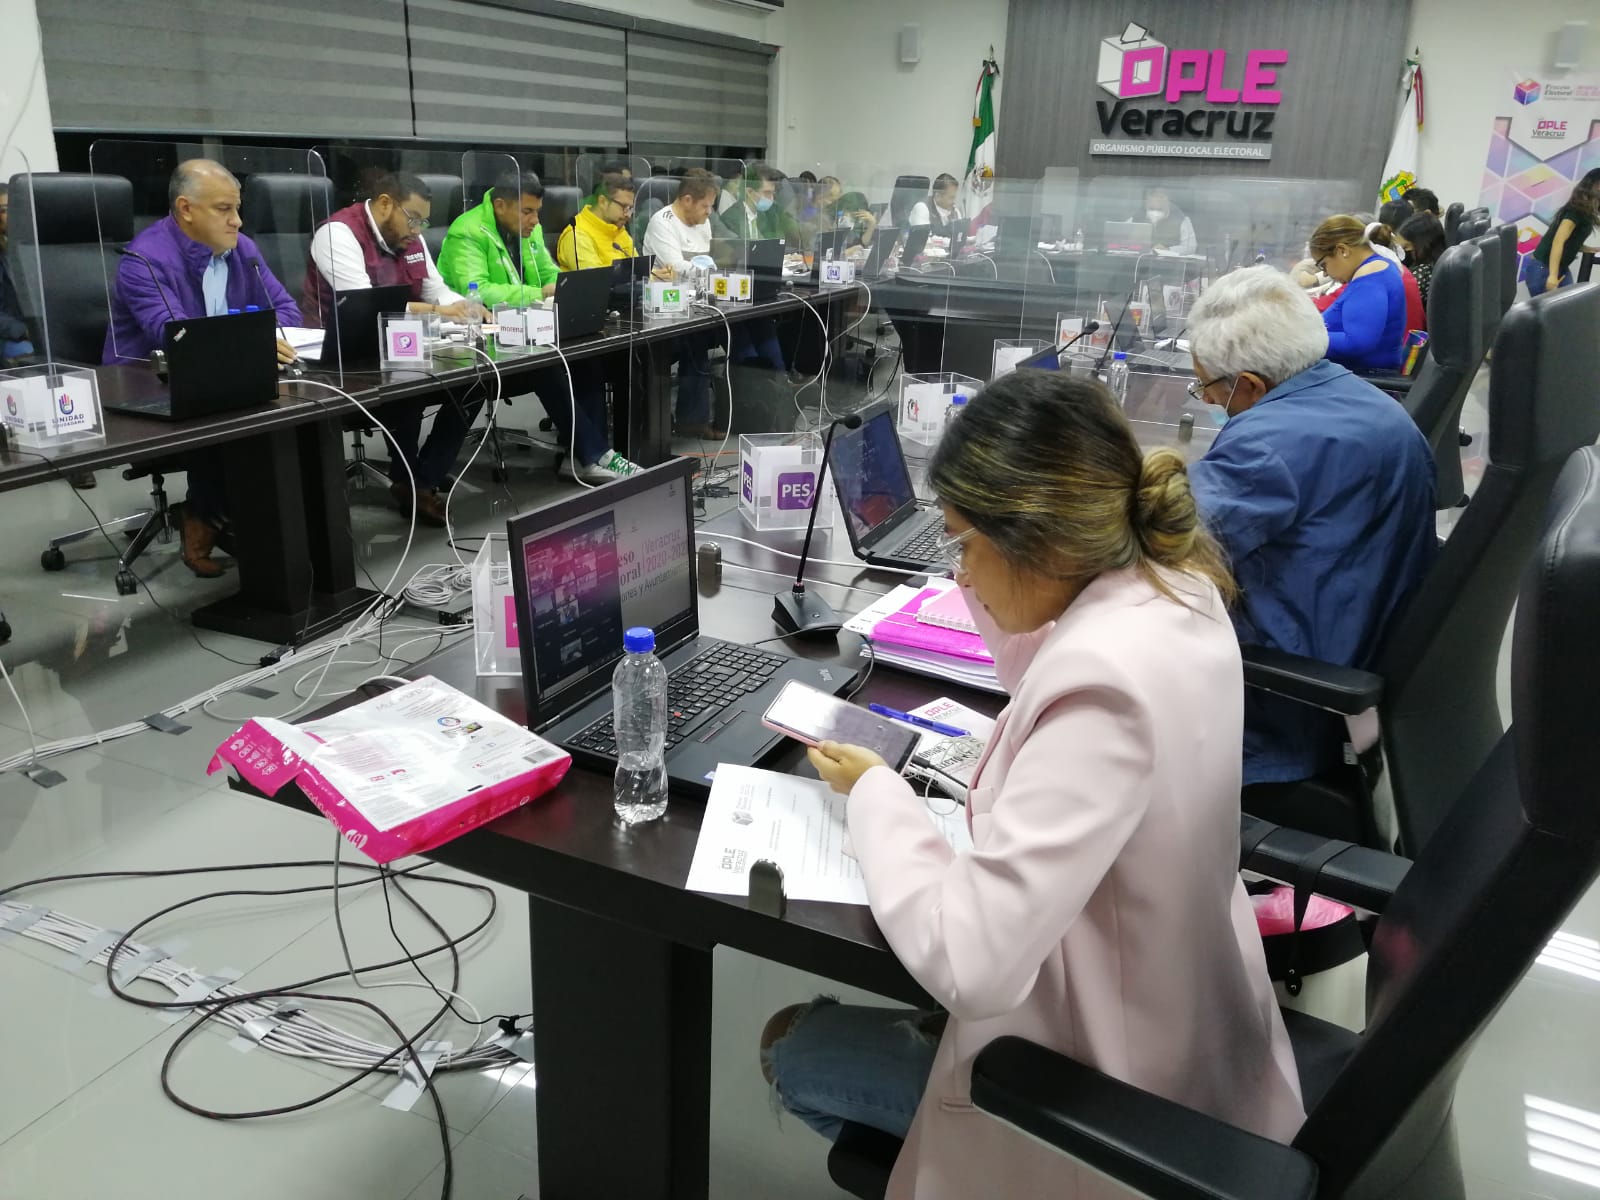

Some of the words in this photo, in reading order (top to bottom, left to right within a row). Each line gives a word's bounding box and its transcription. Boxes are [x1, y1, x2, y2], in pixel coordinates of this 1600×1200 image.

[1119, 46, 1288, 104] OPLE
[1096, 100, 1275, 139] Veracruz
[1093, 143, 1145, 153] ORGANISMO
[1147, 144, 1182, 154] PÚBLICO
[1184, 146, 1212, 155] LOCAL
[1213, 147, 1264, 157] ELECTORAL
[781, 483, 811, 498] PES
